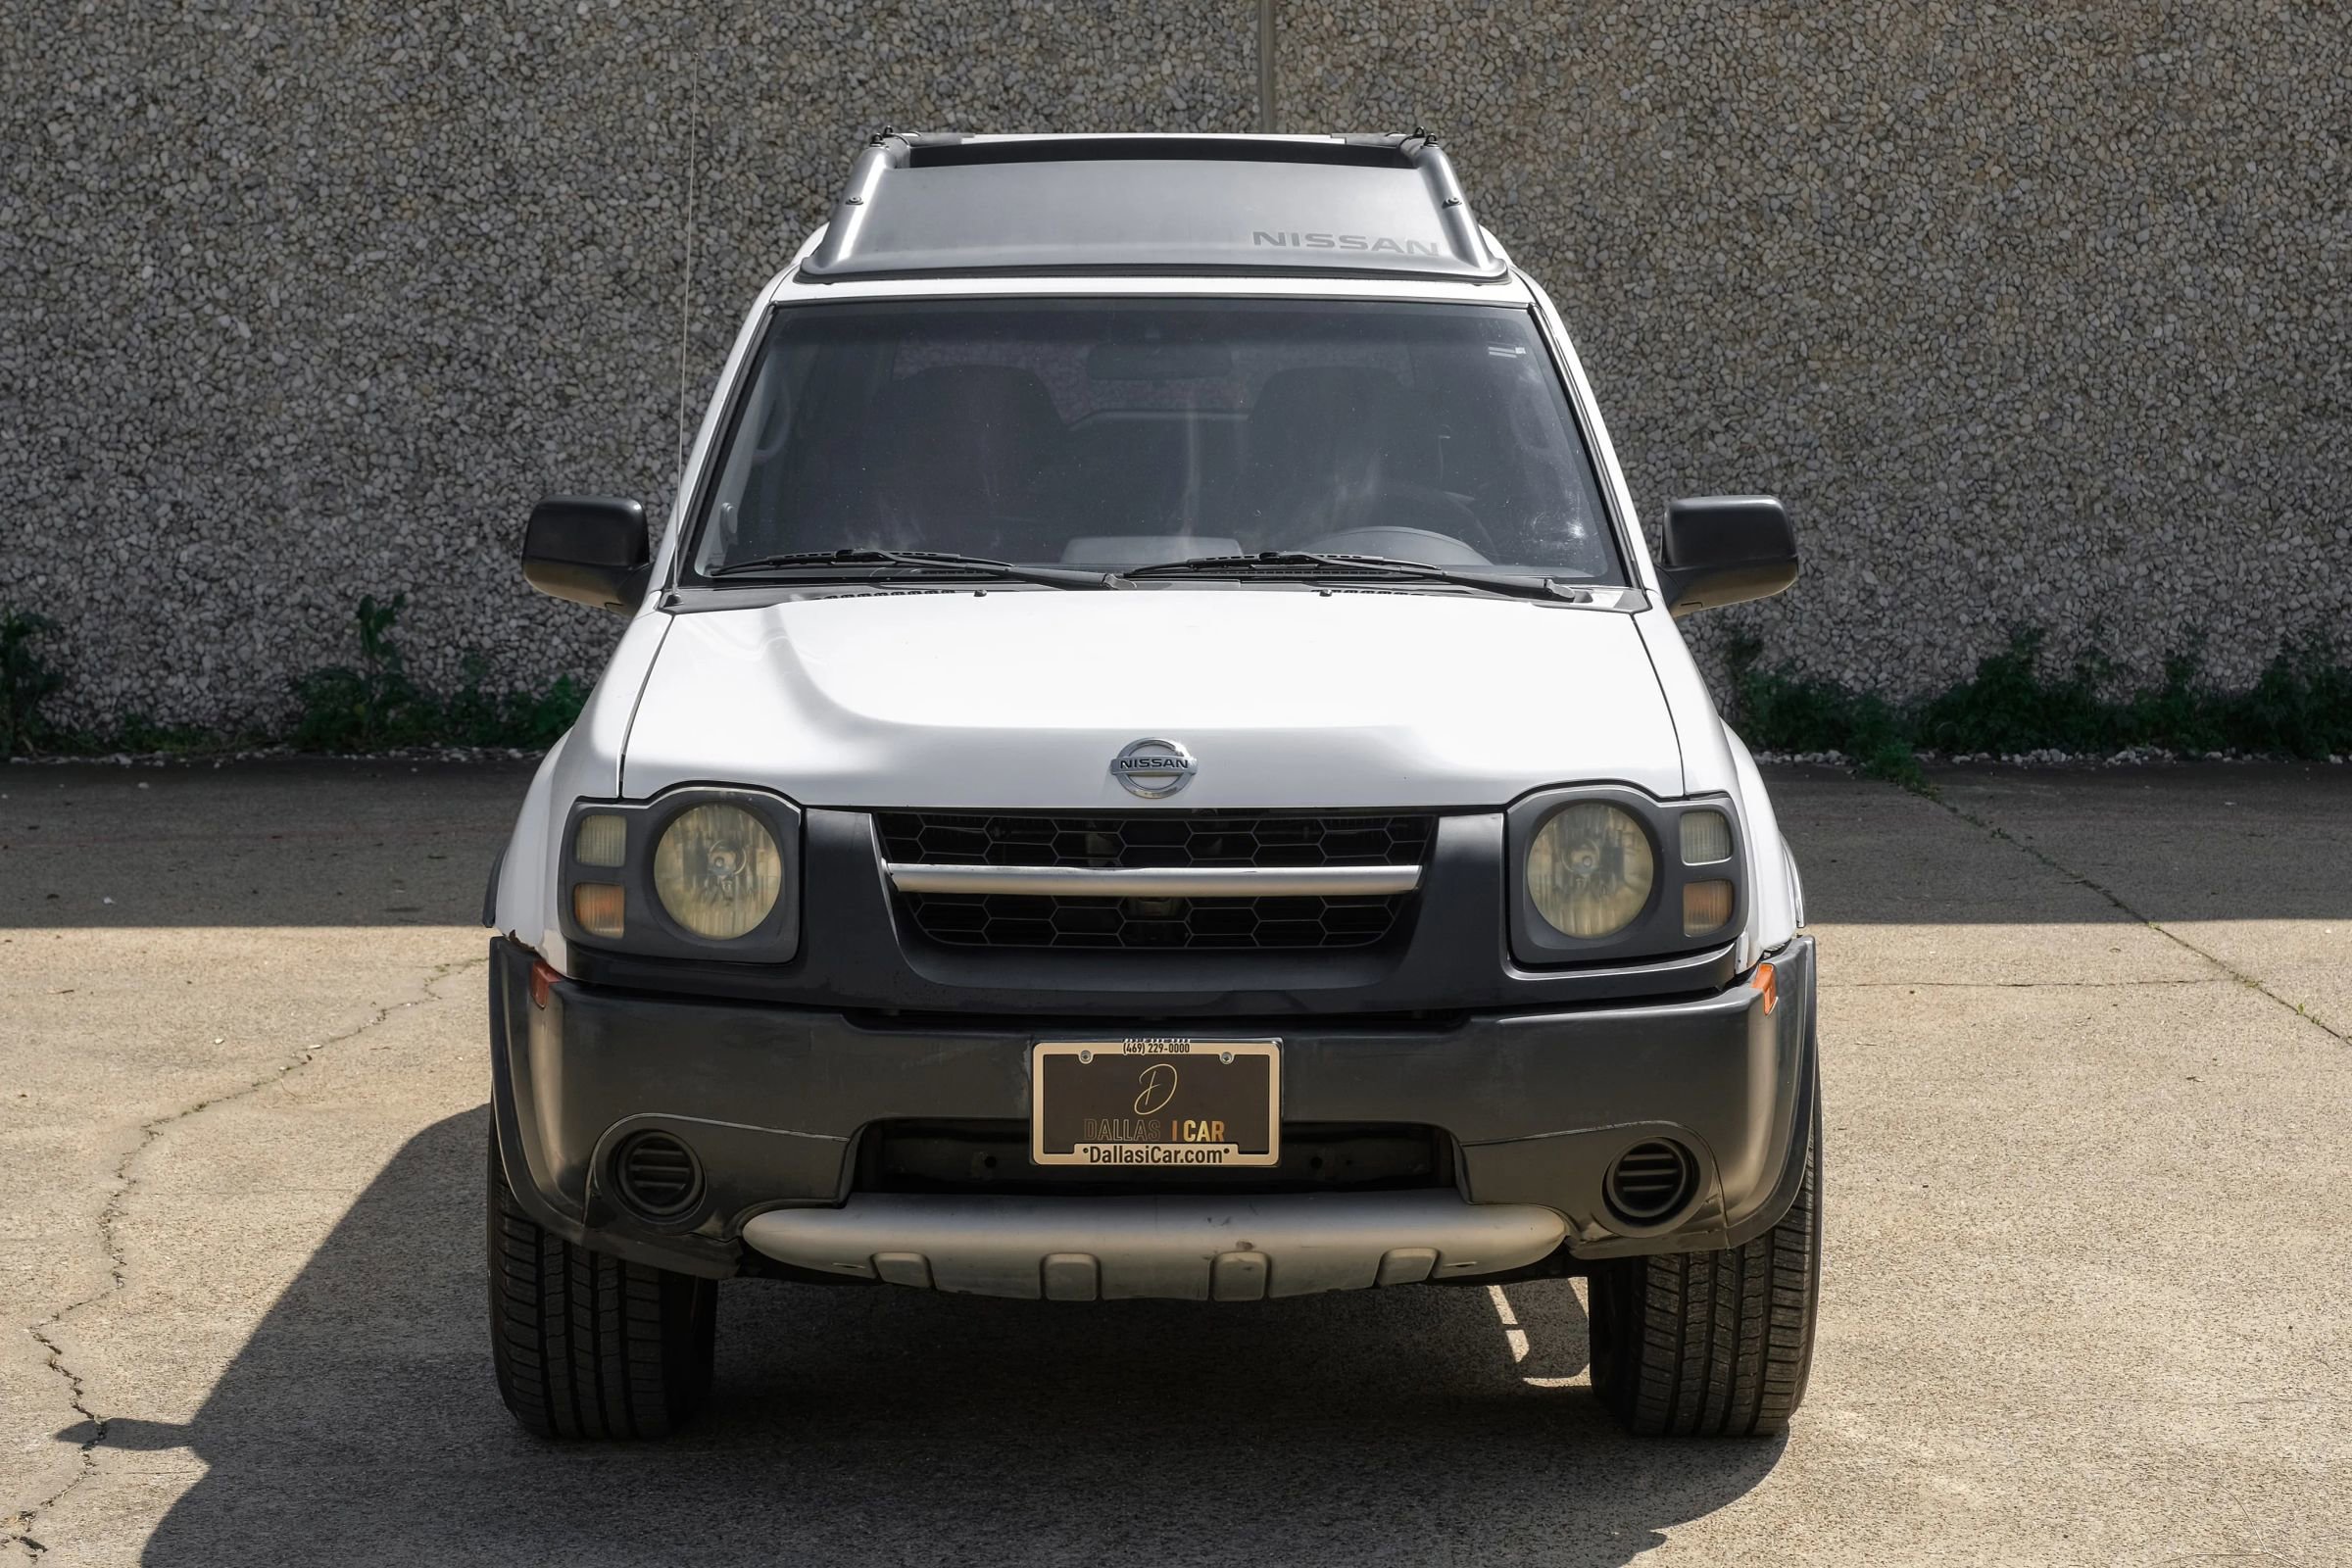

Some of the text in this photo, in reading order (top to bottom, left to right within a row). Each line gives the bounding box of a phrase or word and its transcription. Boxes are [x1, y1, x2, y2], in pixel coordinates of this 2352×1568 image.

[1252, 230, 1440, 257] NISSAN
[1120, 758, 1189, 769] NISSAN
[1123, 1042, 1190, 1054] (469) 229-0000
[1083, 1118, 1161, 1142] DALLAS
[1183, 1119, 1225, 1143] CAR
[1089, 1145, 1223, 1164] DallasiCar.com
